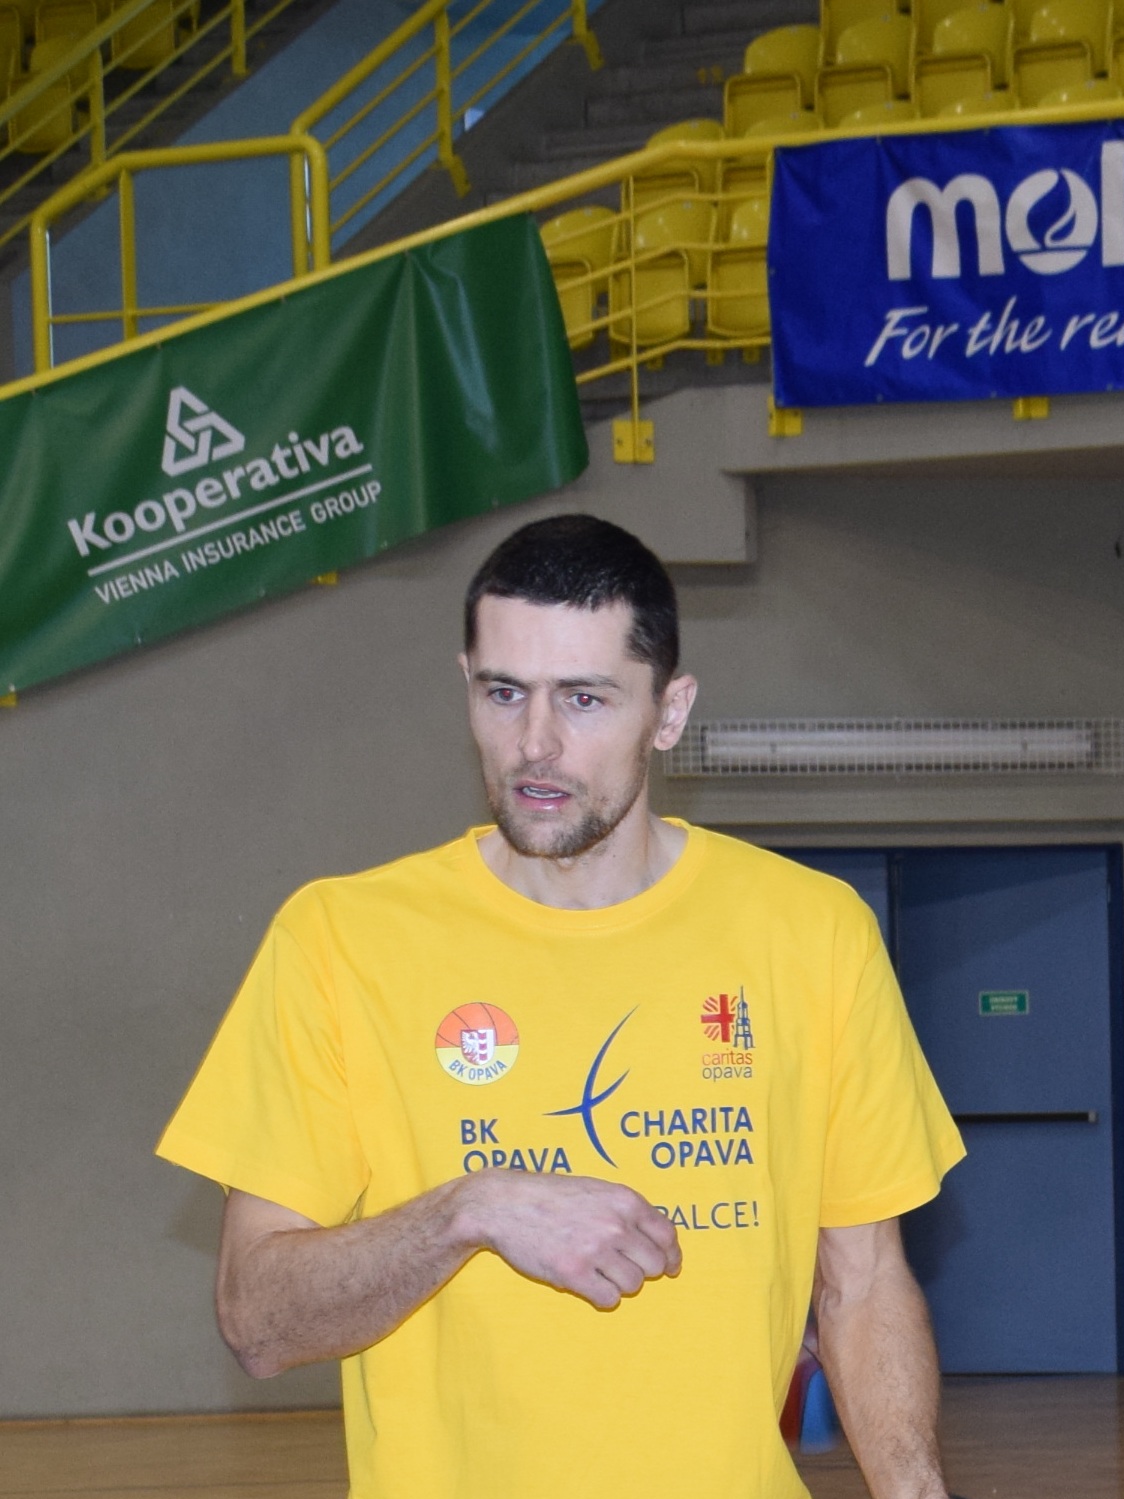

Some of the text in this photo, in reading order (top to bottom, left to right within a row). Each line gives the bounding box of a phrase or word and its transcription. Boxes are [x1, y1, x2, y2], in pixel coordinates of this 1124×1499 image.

[865, 306, 960, 367] For
[966, 295, 1053, 359] the
[67, 425, 365, 557] Kooperativa
[95, 481, 383, 604] VIENNA INSURANCE GROUP
[449, 1059, 507, 1081] BK OPAVA
[702, 1049, 754, 1066] caritas
[702, 1066, 753, 1083] opava
[461, 1118, 499, 1145] BK
[620, 1106, 754, 1138] CHARITA
[463, 1147, 572, 1174] OPAVA
[651, 1138, 755, 1169] OPAVA
